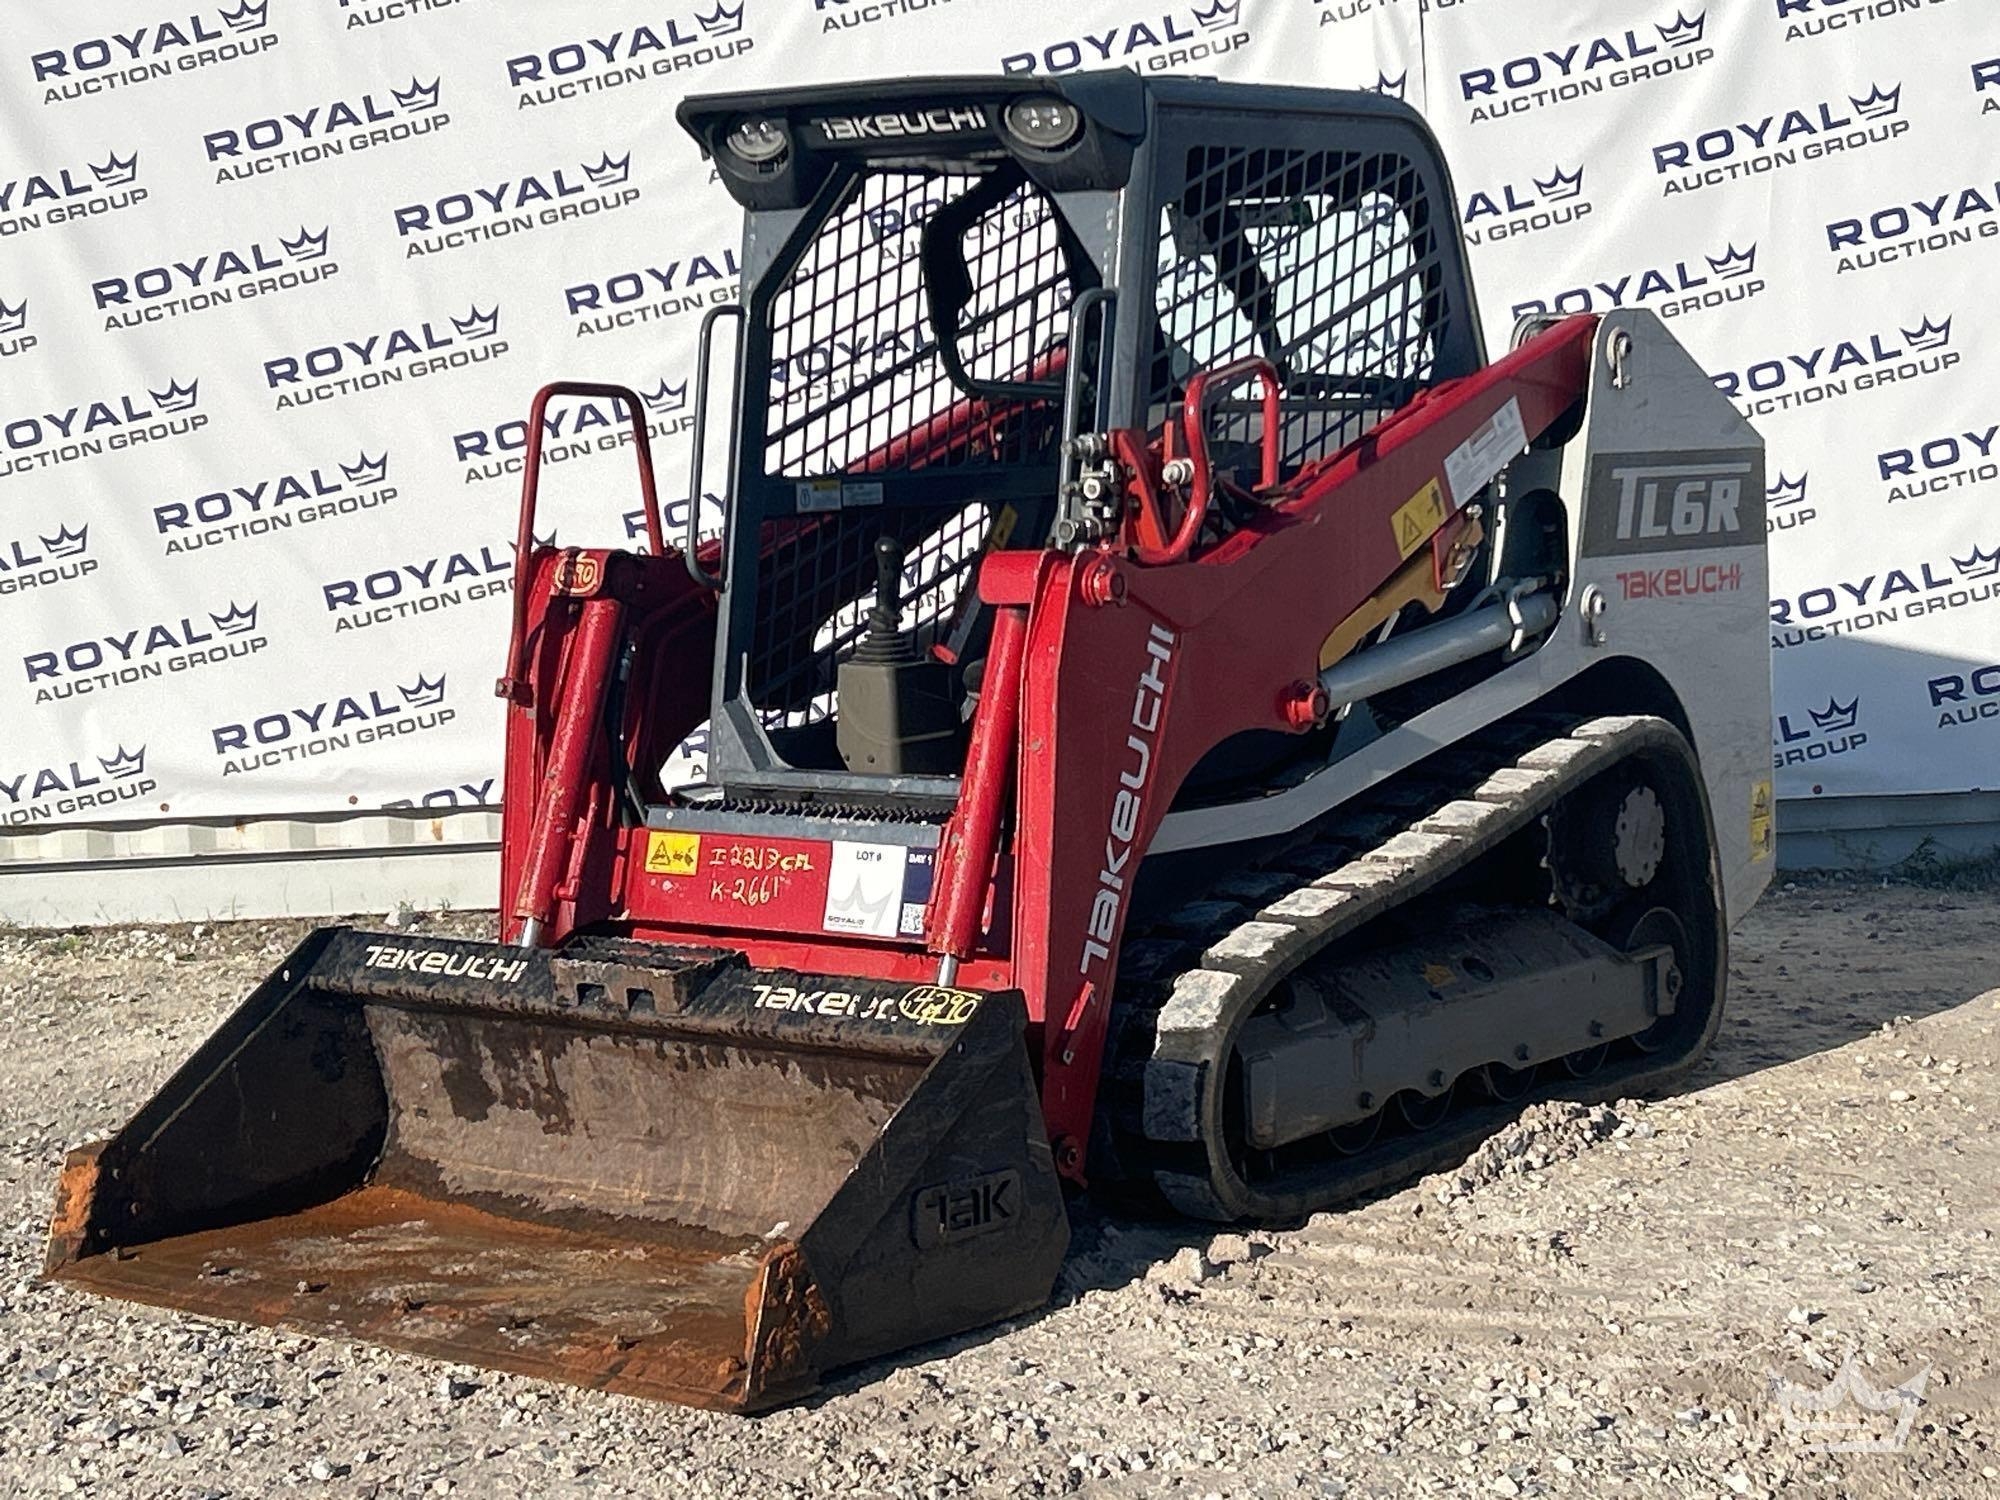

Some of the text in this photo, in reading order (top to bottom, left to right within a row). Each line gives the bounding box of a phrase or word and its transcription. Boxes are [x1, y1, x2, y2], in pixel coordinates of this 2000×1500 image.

[31, 15, 222, 82] ROYAL
[44, 34, 278, 105] AUCTION GROUP
[506, 19, 698, 87] ROYAL
[519, 38, 753, 110] AUCTION GROUP
[1148, 32, 1250, 71] GROUP
[1460, 30, 1657, 101] ROYAL
[1470, 48, 1713, 124] AUCTION GROUP
[203, 95, 394, 162] ROYAL
[216, 114, 450, 184] AUCTION GROUP
[1652, 103, 1851, 174] ROYAL
[1664, 120, 1909, 197] AUCTION GROUP
[0, 170, 93, 211] YAL
[47, 189, 148, 224] GROUP
[394, 170, 584, 236] ROYAL
[1488, 202, 1592, 241] GROUP
[1826, 181, 2000, 252] ROYA
[407, 188, 640, 259] AUCTION GROUP
[1837, 227, 1971, 274] AUCTION
[92, 244, 283, 309] ROYAL
[105, 263, 338, 332] AUCTION GROUP
[1660, 280, 1765, 318] GROUP
[577, 293, 703, 337] AUCTION
[264, 323, 453, 388] ROYAL
[276, 342, 508, 411] AUCTION GROUP
[1854, 352, 1960, 390] GROUP
[0, 414, 208, 477] UCTION GROUP
[3, 396, 152, 451] OYAL
[1878, 426, 2000, 482] ROY
[466, 441, 592, 484] AUCION
[1888, 463, 2000, 504] AUCTIO
[154, 470, 342, 534] ROYAL
[166, 488, 397, 555] AUCTION GROUP
[1611, 462, 1752, 540] TL6R
[0, 560, 98, 594] GROUP
[323, 547, 511, 611] ROYAL
[336, 590, 461, 633] AUCTION
[1772, 608, 1898, 650] AUCTION
[23, 619, 212, 683] ROYAL
[36, 637, 267, 704] AUCTION GROUP
[212, 691, 401, 755] ROYAL
[223, 709, 455, 776] AUCTION GROUP
[0, 762, 100, 803] YAL
[57, 779, 157, 815] GROUP
[856, 850, 875, 861] LOT
